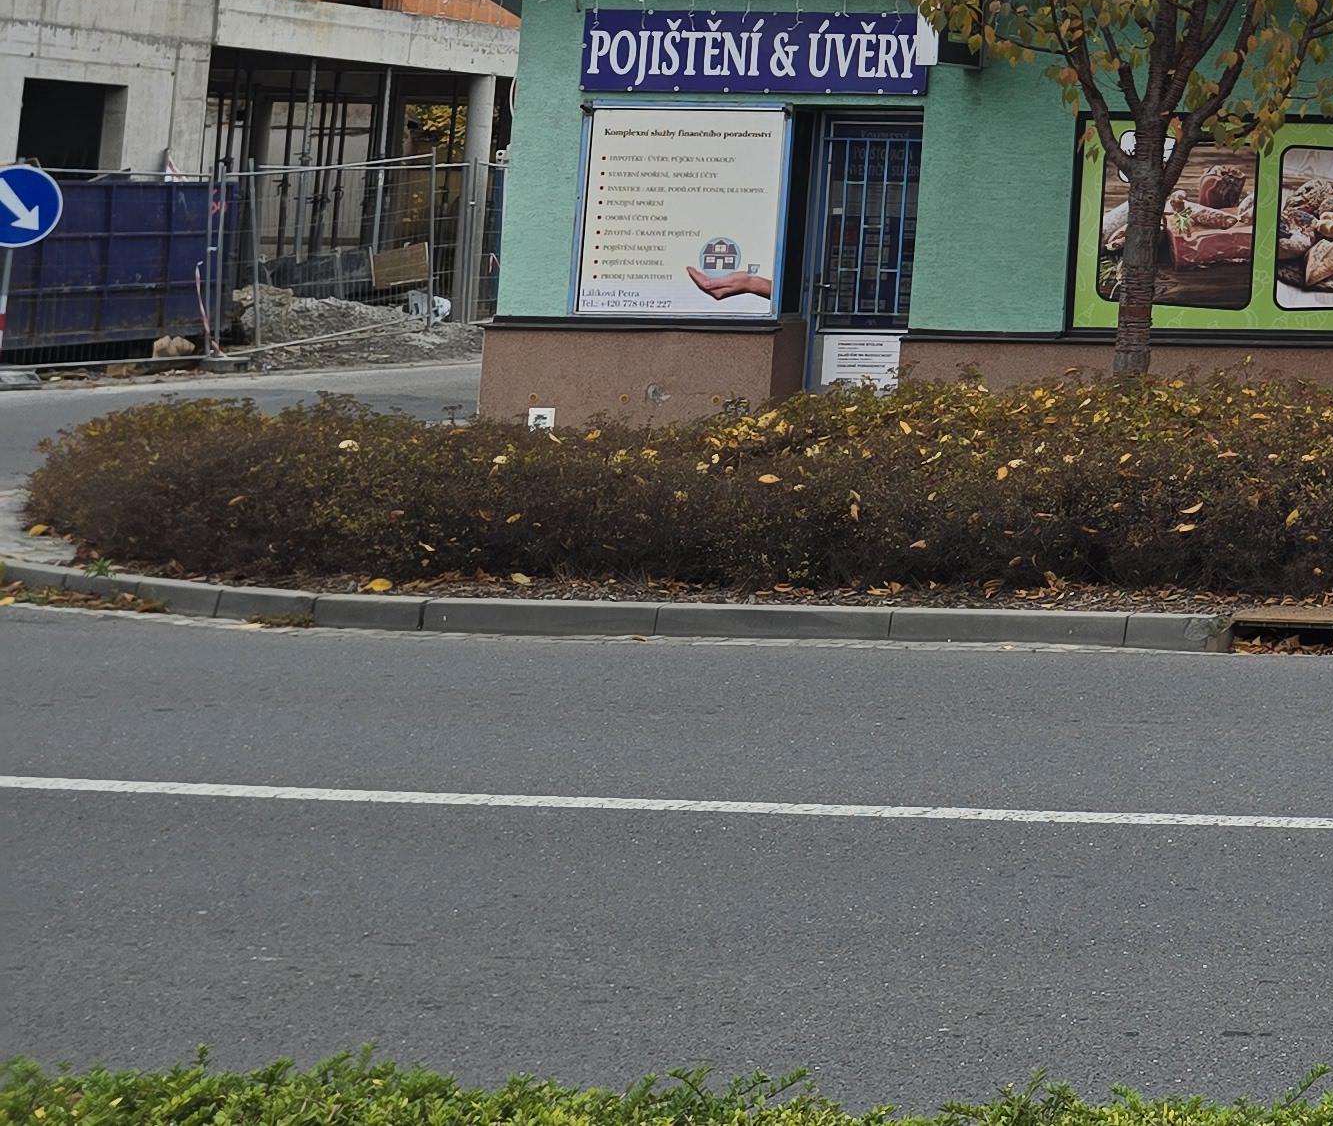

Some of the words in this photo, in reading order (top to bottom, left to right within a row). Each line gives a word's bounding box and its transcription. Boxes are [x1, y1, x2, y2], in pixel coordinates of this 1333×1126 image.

[587, 18, 764, 86] POJIŠTĚNÍ
[769, 32, 800, 77] &
[808, 19, 917, 79] ÚVĚRY
[604, 128, 650, 138] Komplexní
[651, 130, 676, 139] služby
[678, 130, 722, 138] finančního
[723, 131, 772, 139] poradenství
[618, 290, 640, 298] Petra
[623, 300, 637, 308] 778
